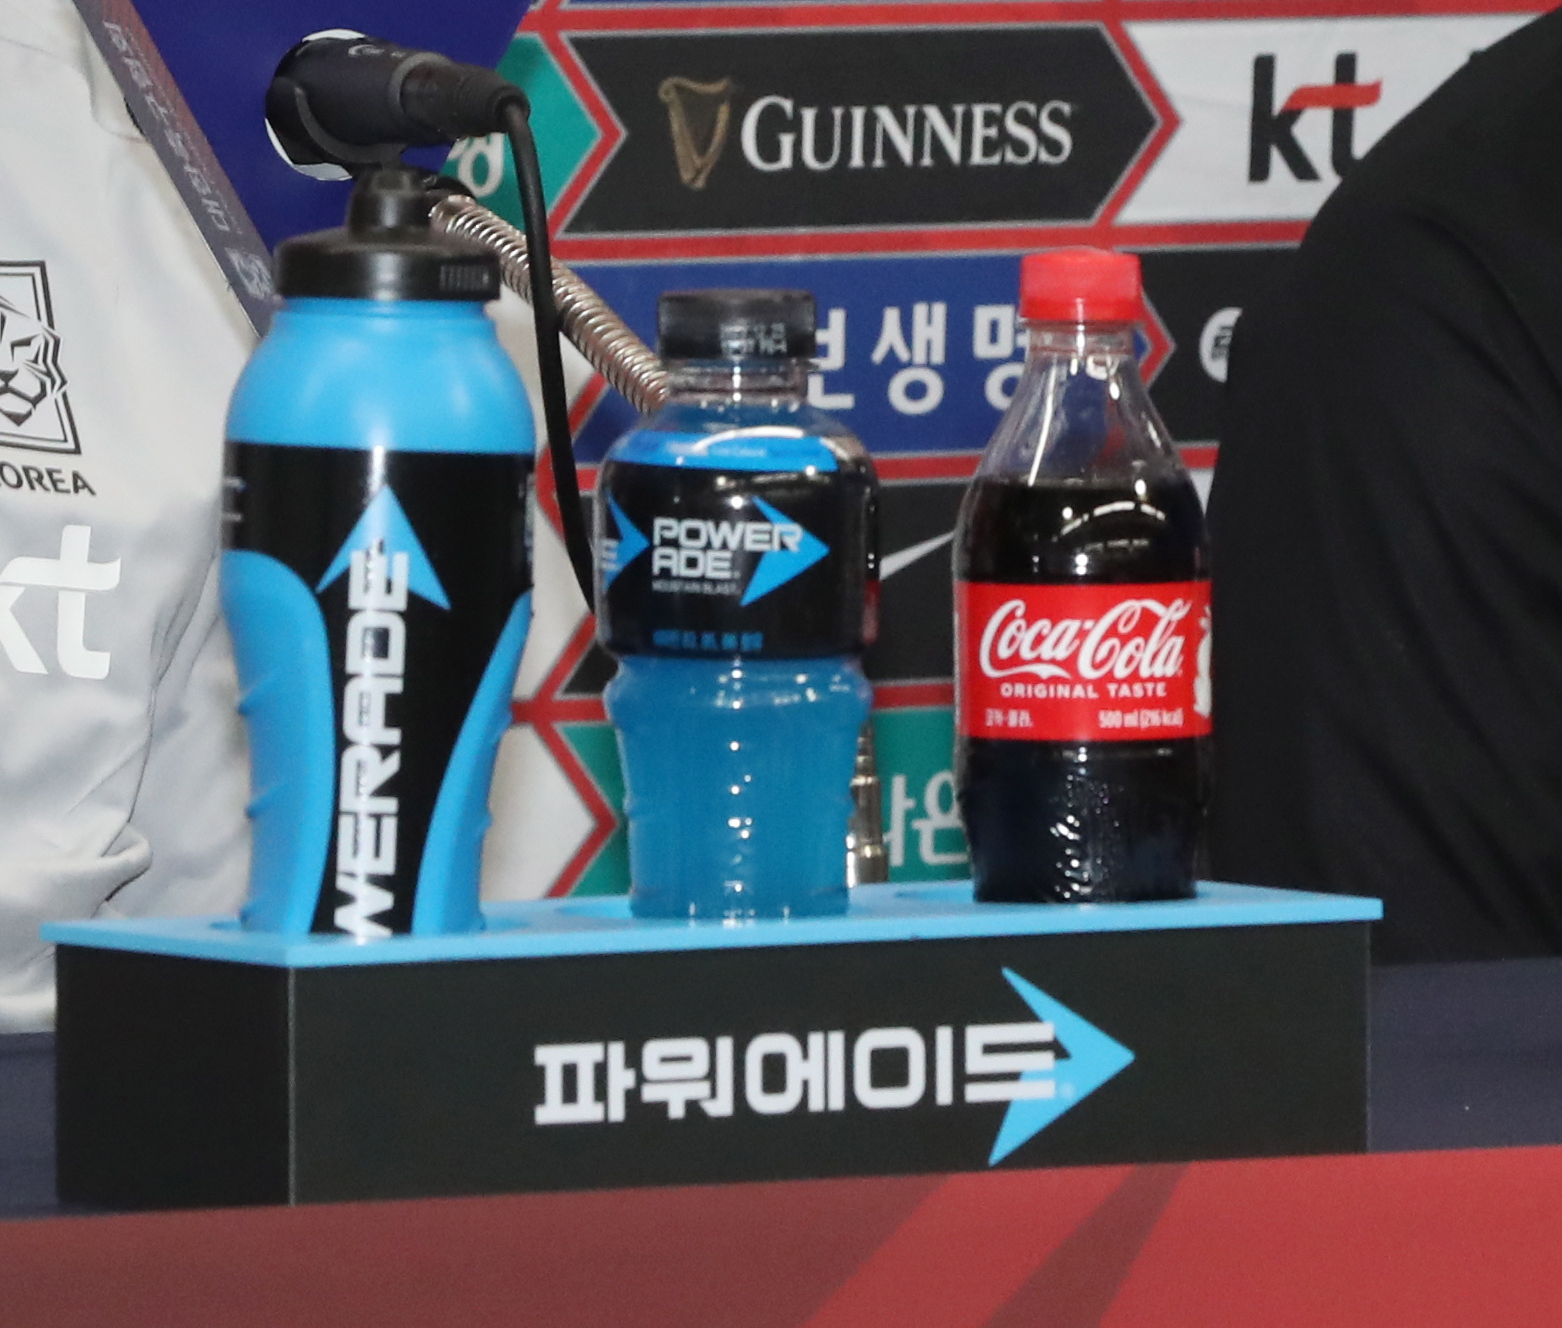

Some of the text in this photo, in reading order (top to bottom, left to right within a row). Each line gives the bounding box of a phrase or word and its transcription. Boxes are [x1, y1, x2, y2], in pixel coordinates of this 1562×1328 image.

[741, 96, 1072, 171] GUINNESS
[1247, 52, 1383, 185] kt
[651, 517, 804, 553] POWER
[651, 548, 734, 579] ADE
[979, 598, 1193, 680] Coca-Cola
[1000, 682, 1167, 699] ORIGINAL TASTE
[533, 1021, 1056, 1128] 파워에이드
